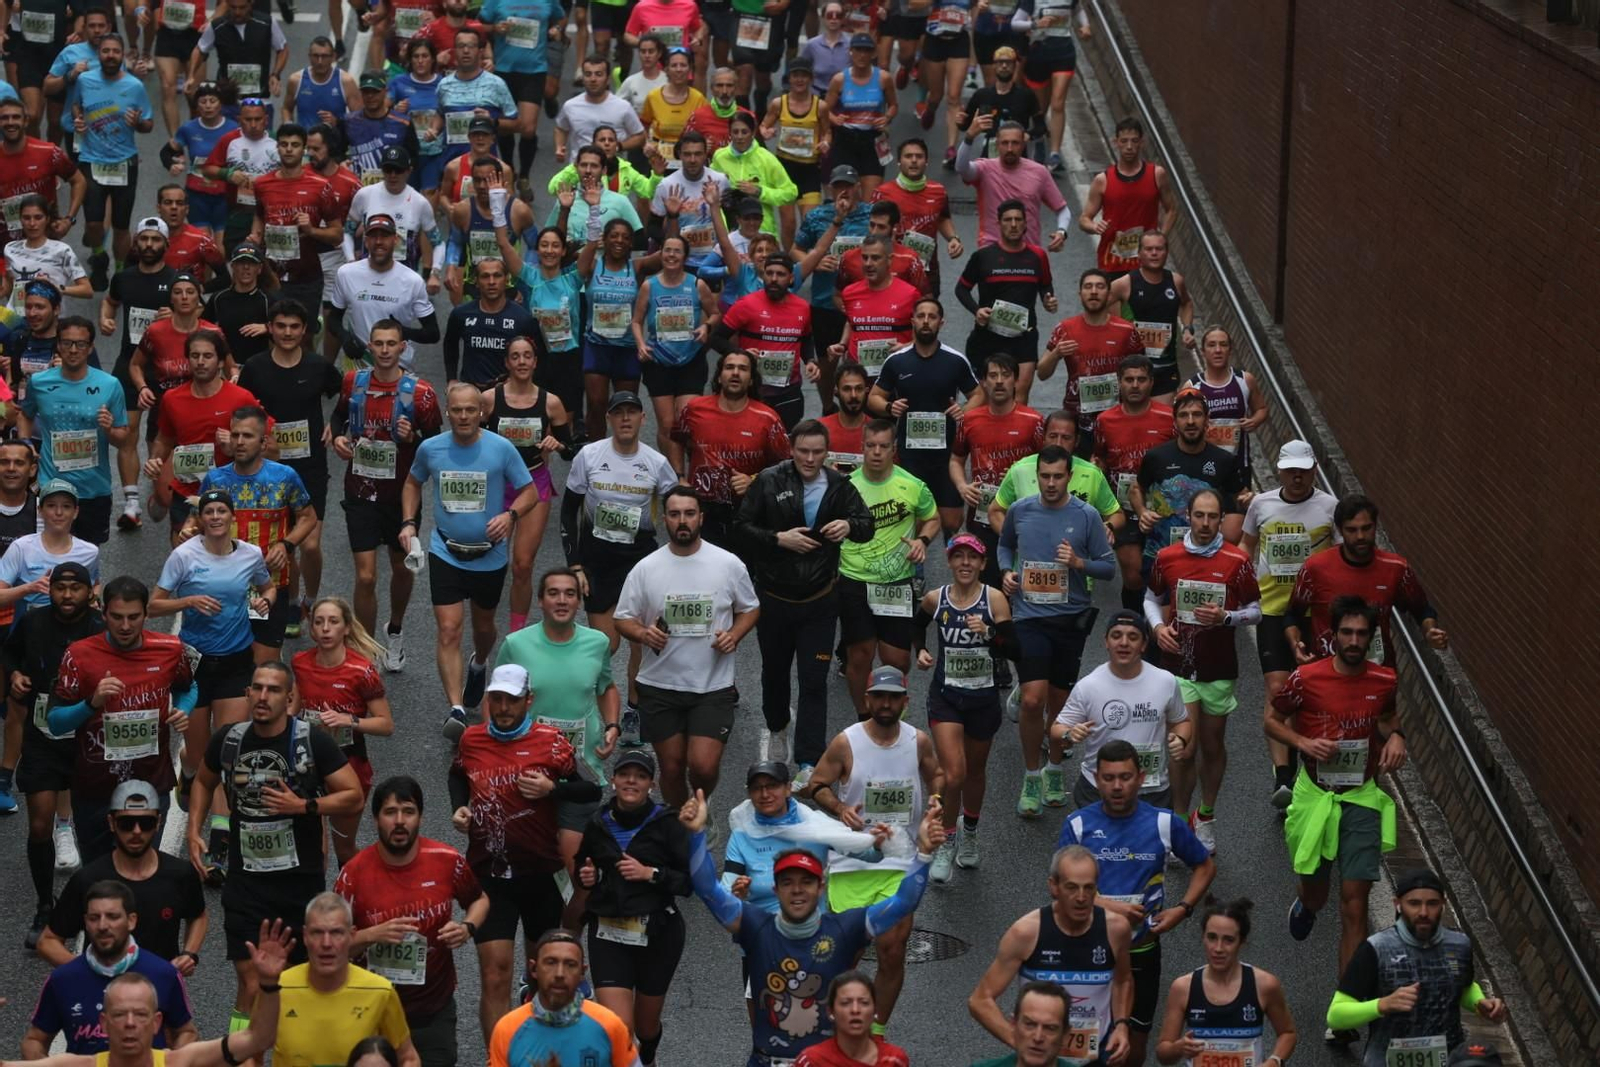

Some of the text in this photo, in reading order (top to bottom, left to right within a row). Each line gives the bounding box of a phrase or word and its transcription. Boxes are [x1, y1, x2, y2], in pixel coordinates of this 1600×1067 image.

[997, 308, 1020, 323] 9274
[471, 336, 505, 350] FRANCE
[763, 361, 788, 371] 6585
[1085, 384, 1111, 397] 7809
[912, 421, 938, 433] 8996
[276, 430, 302, 444] 2010
[179, 454, 205, 467] 7842
[443, 481, 480, 496] 10312
[601, 510, 629, 527] 7508
[1272, 544, 1301, 558] 6849
[1029, 572, 1058, 586] 5819
[874, 585, 902, 599] 6760
[1183, 590, 1214, 605] 8367
[671, 603, 703, 617] 7168
[941, 628, 983, 645] VISA
[1132, 709, 1158, 718] MADRID
[111, 725, 149, 740] 9556
[872, 790, 906, 806] 7548
[247, 833, 282, 850] 9881
[375, 944, 413, 961] 9162
[1395, 1050, 1434, 1067] 8191
